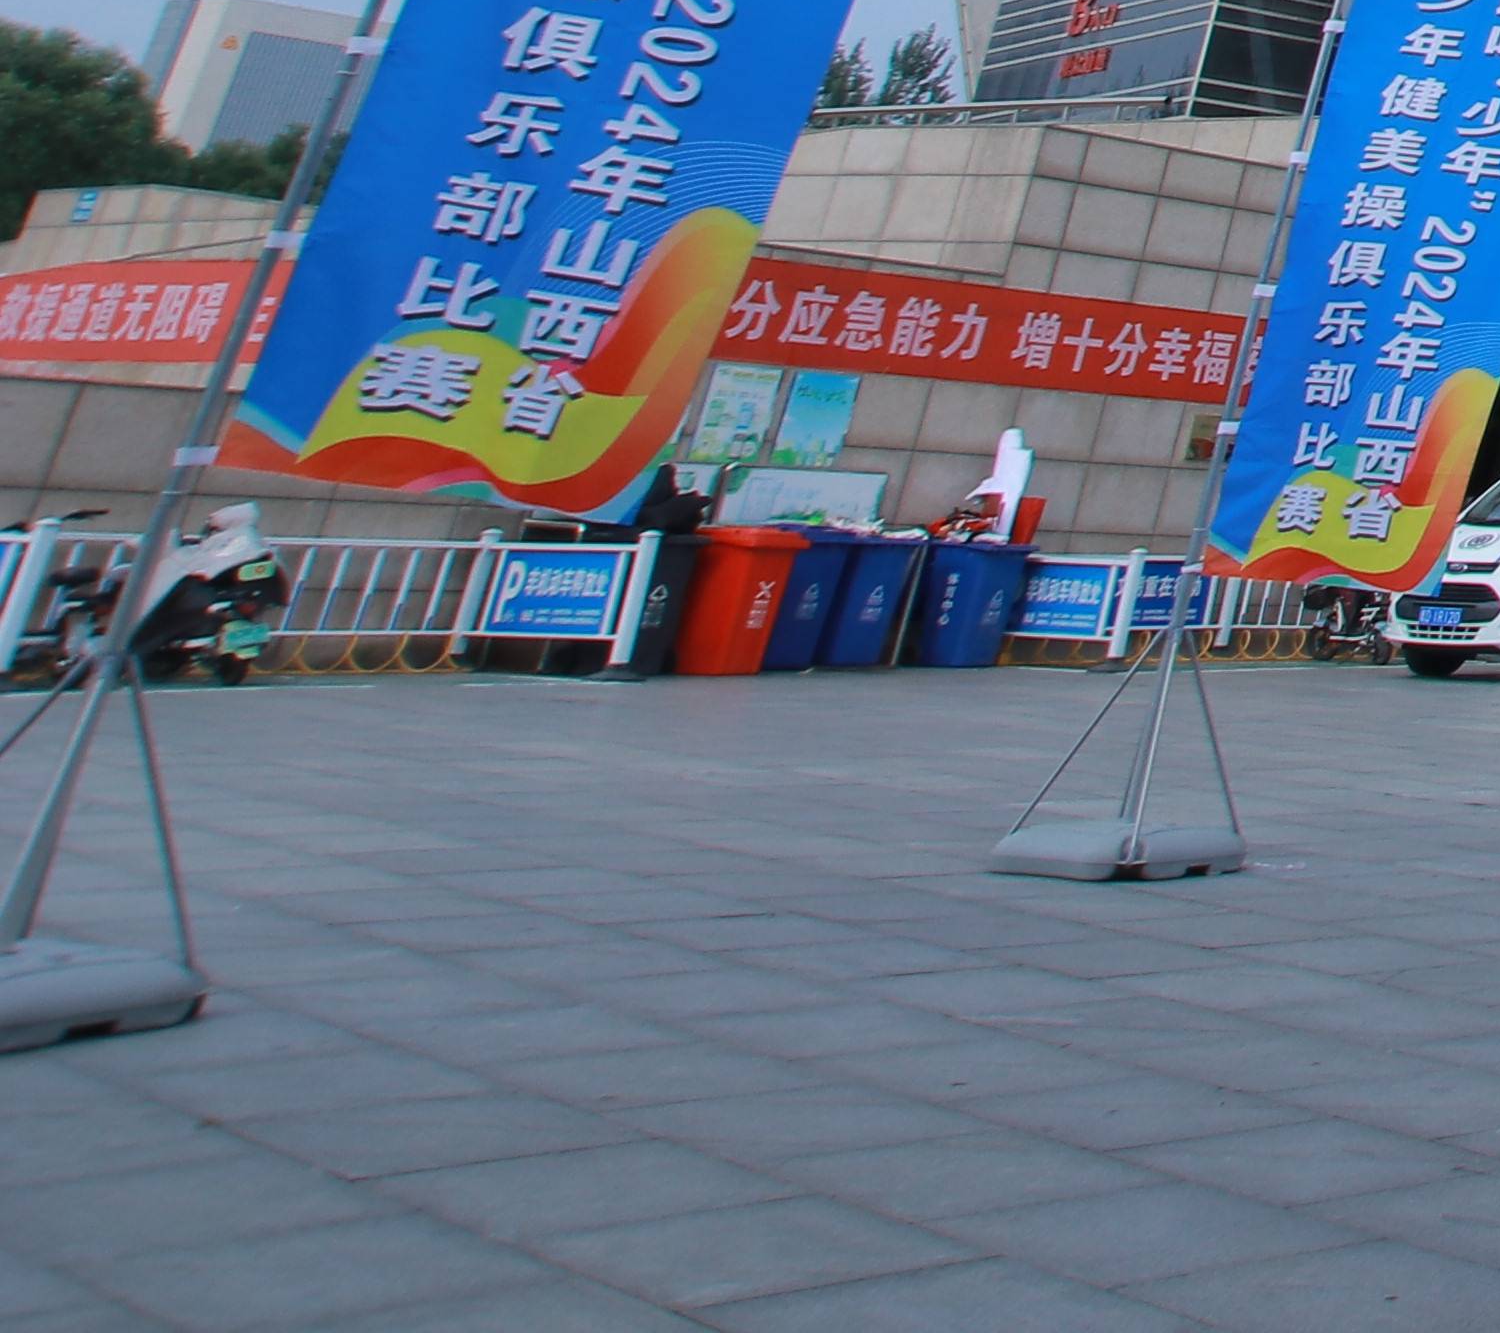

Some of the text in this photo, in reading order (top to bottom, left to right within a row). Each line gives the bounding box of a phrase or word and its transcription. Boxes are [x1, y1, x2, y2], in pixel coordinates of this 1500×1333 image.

[0, 281, 231, 344] 救援通道无阻碍
[726, 278, 989, 361] 分应急能力
